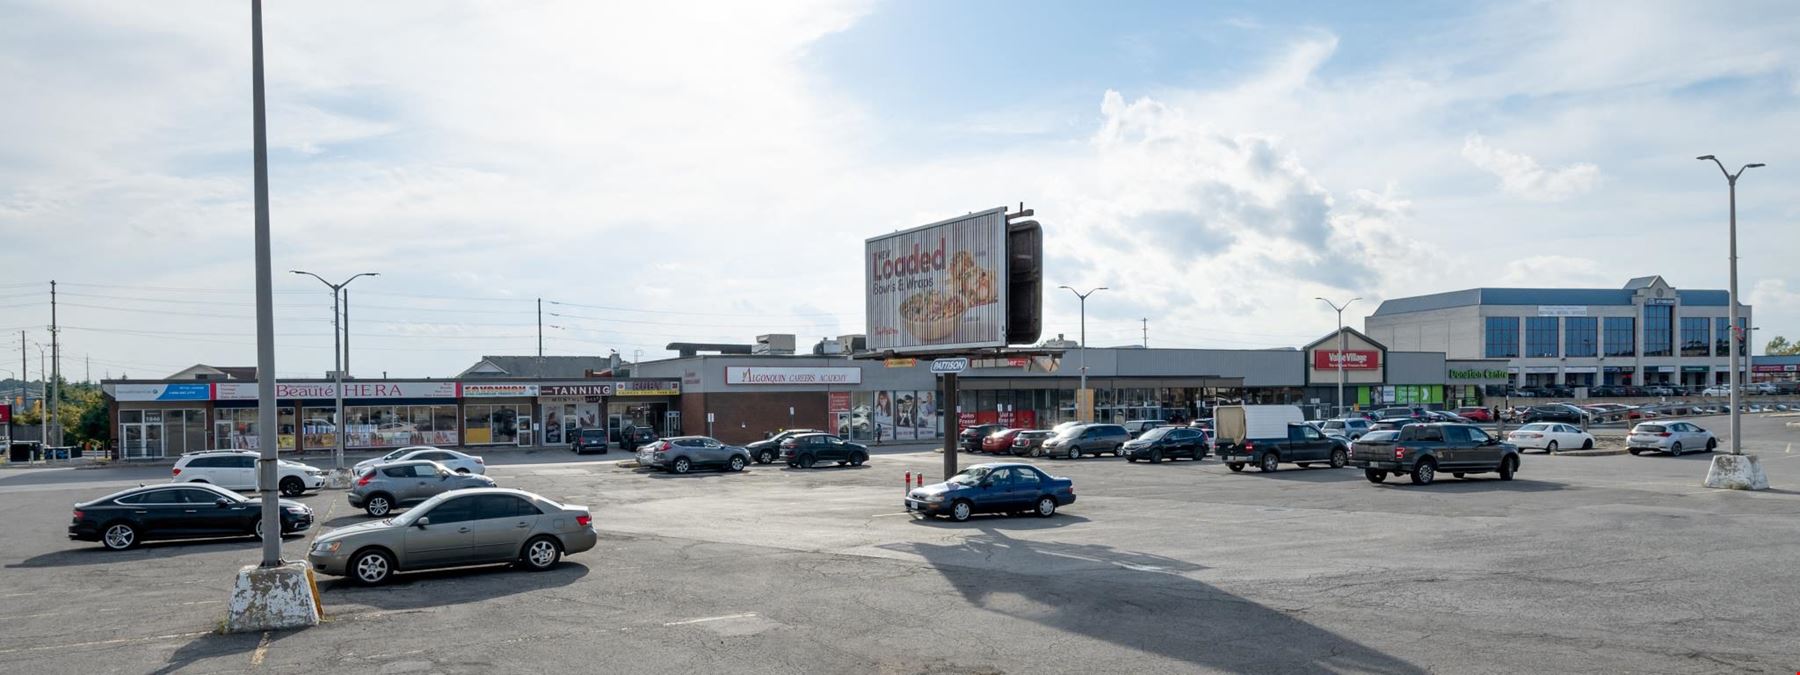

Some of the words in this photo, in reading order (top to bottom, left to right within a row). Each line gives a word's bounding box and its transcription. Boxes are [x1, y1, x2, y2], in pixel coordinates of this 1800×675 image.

[873, 238, 945, 281] Loaded
[873, 282, 896, 296] Bows
[906, 276, 934, 291] Wraps
[1328, 352, 1346, 362] Vale
[1346, 352, 1367, 364] Village
[932, 361, 964, 370] PATTISON
[742, 367, 785, 383] ALGONQUIN
[789, 374, 816, 383] CAREERS
[819, 374, 847, 383] ACADEMY
[1449, 368, 1482, 379] Donation
[276, 384, 334, 398] Beauté
[344, 384, 402, 397] HERA
[552, 385, 610, 395] TANNING
